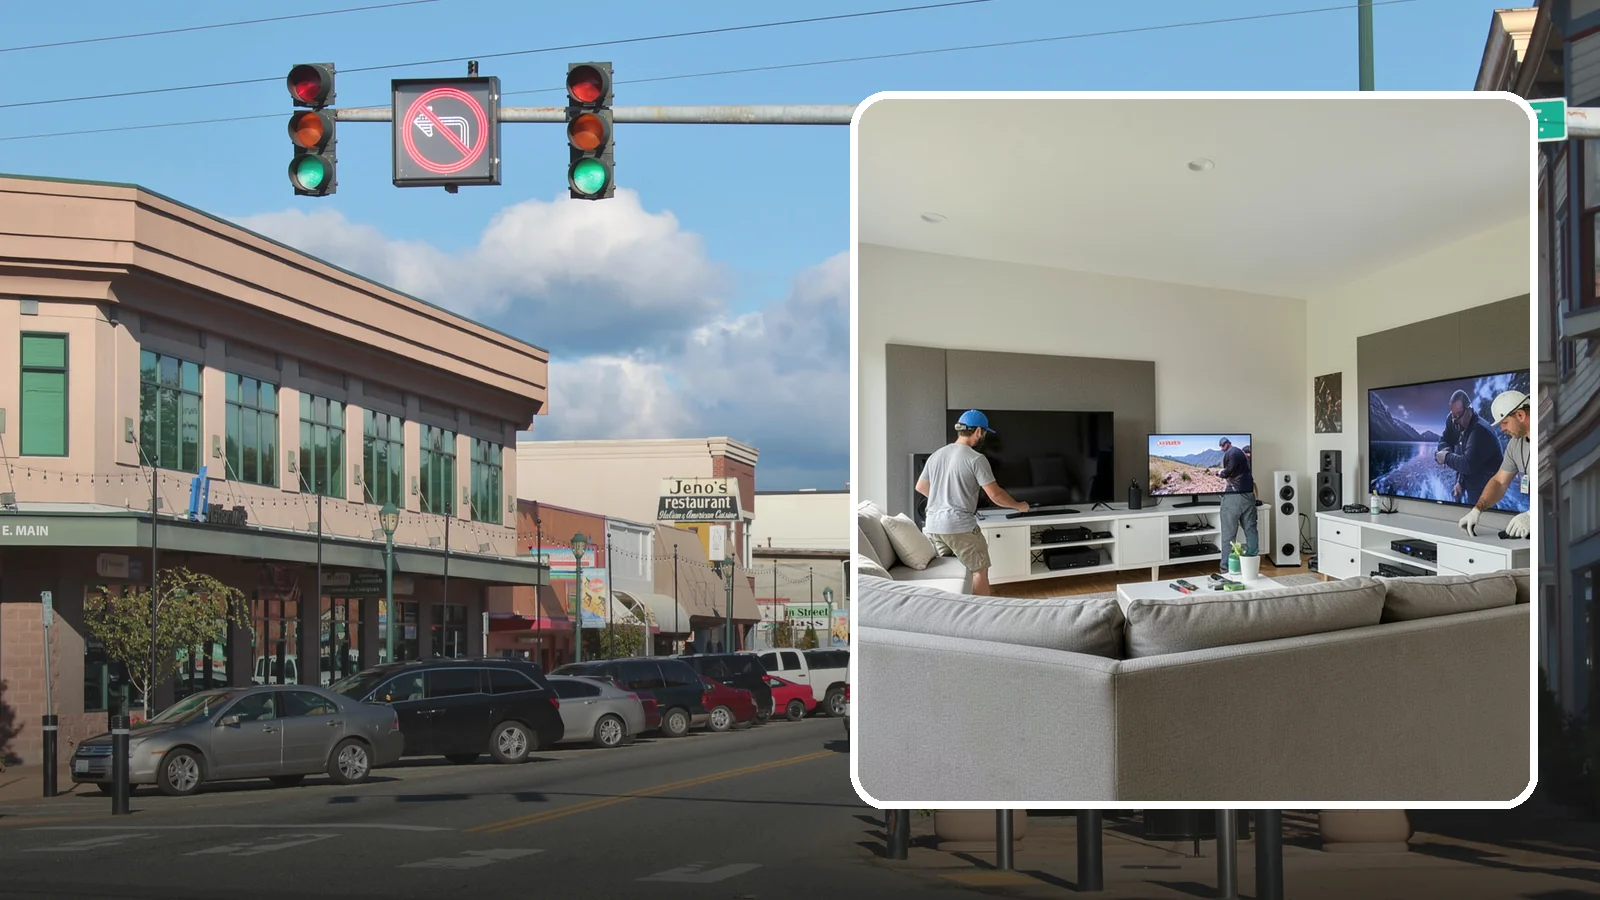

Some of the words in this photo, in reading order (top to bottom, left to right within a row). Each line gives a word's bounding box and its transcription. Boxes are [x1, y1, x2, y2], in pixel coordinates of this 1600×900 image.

[669, 480, 728, 494] Jeno's
[665, 497, 731, 509] restaurant
[658, 510, 681, 519] Italian
[686, 509, 714, 519] American
[715, 509, 738, 519] Cuisine
[2, 525, 13, 536] E.
[15, 525, 49, 536] MAIN
[797, 607, 829, 617] Street
